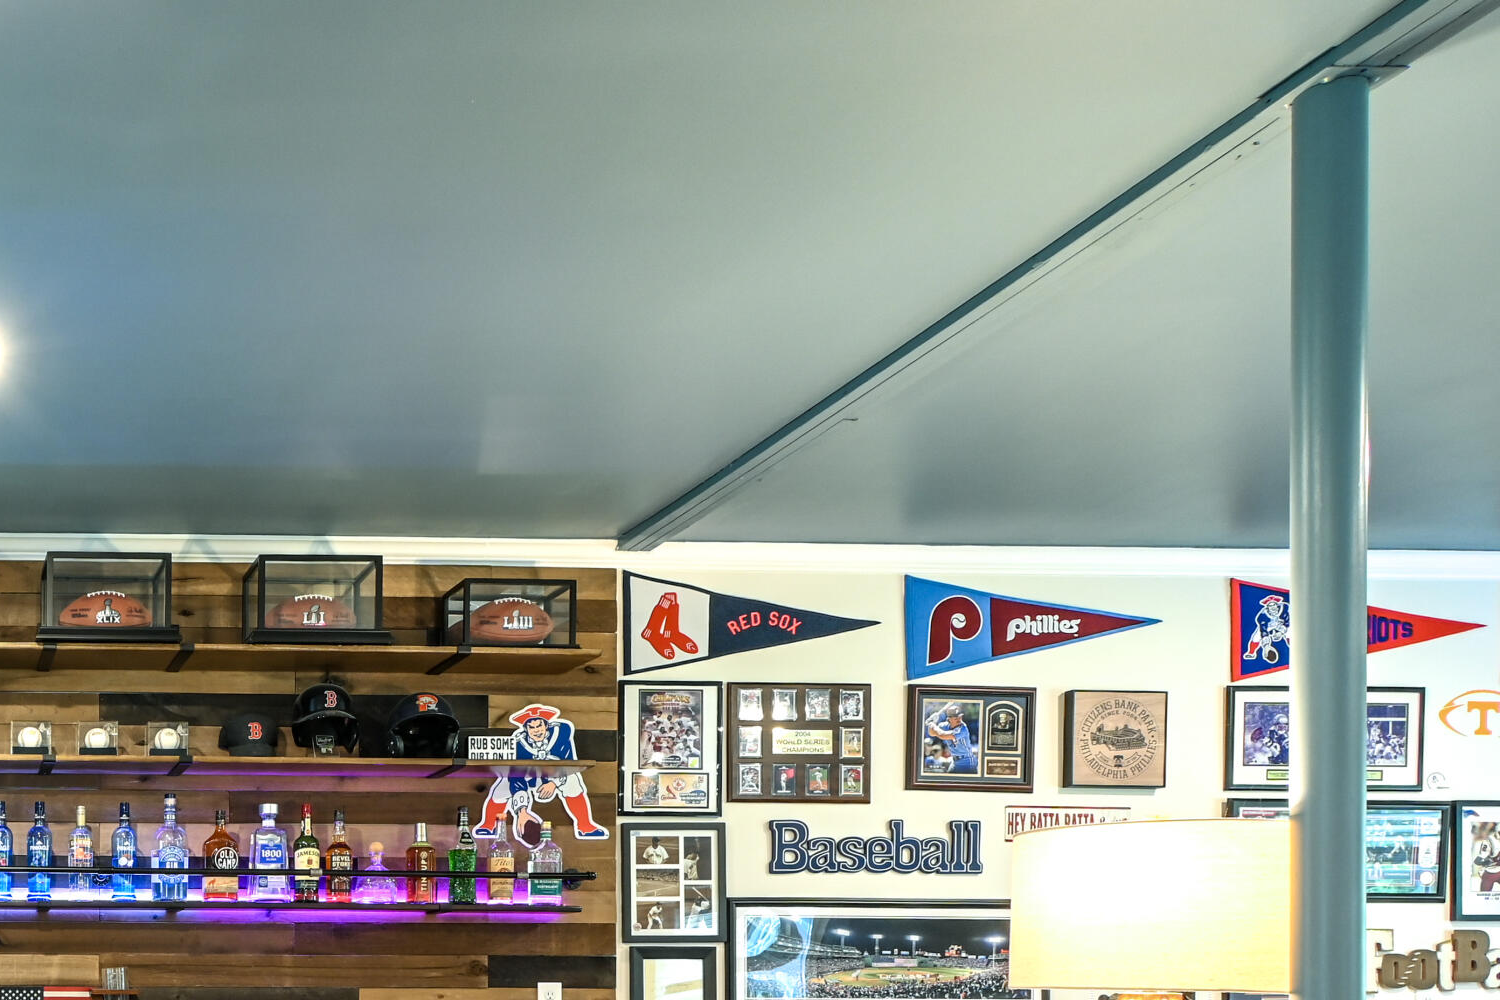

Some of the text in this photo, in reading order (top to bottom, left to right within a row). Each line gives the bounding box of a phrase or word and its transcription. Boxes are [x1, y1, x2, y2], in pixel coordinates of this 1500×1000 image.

[95, 615, 121, 624] XLIX
[726, 610, 802, 635] RED SOX
[1006, 614, 1081, 642] phillies
[324, 690, 338, 708] B
[1081, 699, 1157, 735] CITIZENS BANK PARK
[247, 721, 263, 740] B
[470, 737, 515, 750] RUB SOME
[470, 752, 515, 760] DIRT ON IT
[1080, 738, 1158, 780] PHILADELPHIA PHILLIES
[1007, 812, 1027, 835] HEY
[220, 849, 235, 859] OLD
[261, 849, 282, 858] 1800
[768, 819, 984, 875] Baseball
[217, 858, 236, 869] CAMP
